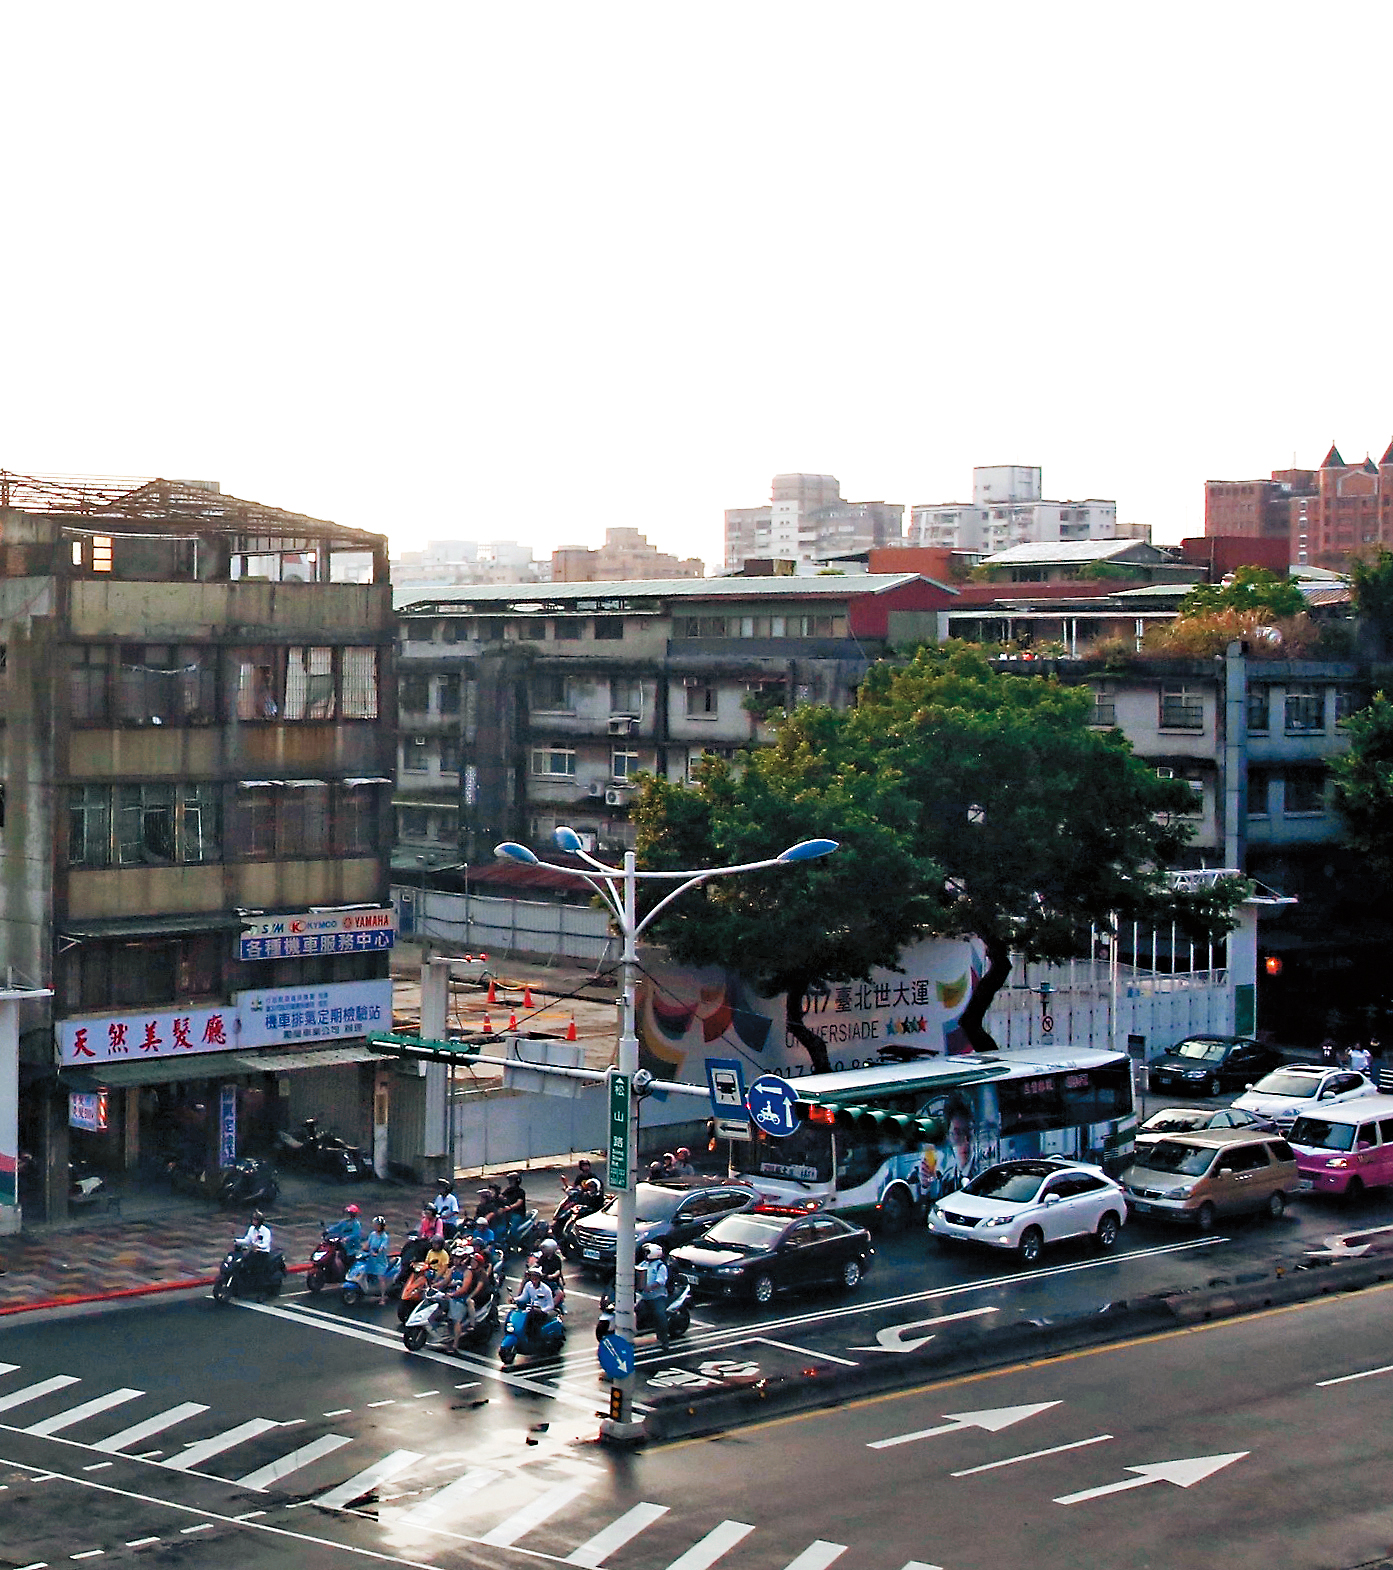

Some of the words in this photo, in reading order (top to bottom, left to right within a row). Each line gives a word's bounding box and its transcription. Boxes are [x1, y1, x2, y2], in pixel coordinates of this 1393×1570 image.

[307, 919, 338, 931] KYMCO
[355, 914, 390, 928] YAMAHA
[246, 931, 390, 958] 各種機車服務中心
[834, 980, 929, 1013] 臺北世大運
[73, 1014, 227, 1057] 天然美髮廳
[613, 1084, 626, 1148] 松山路
